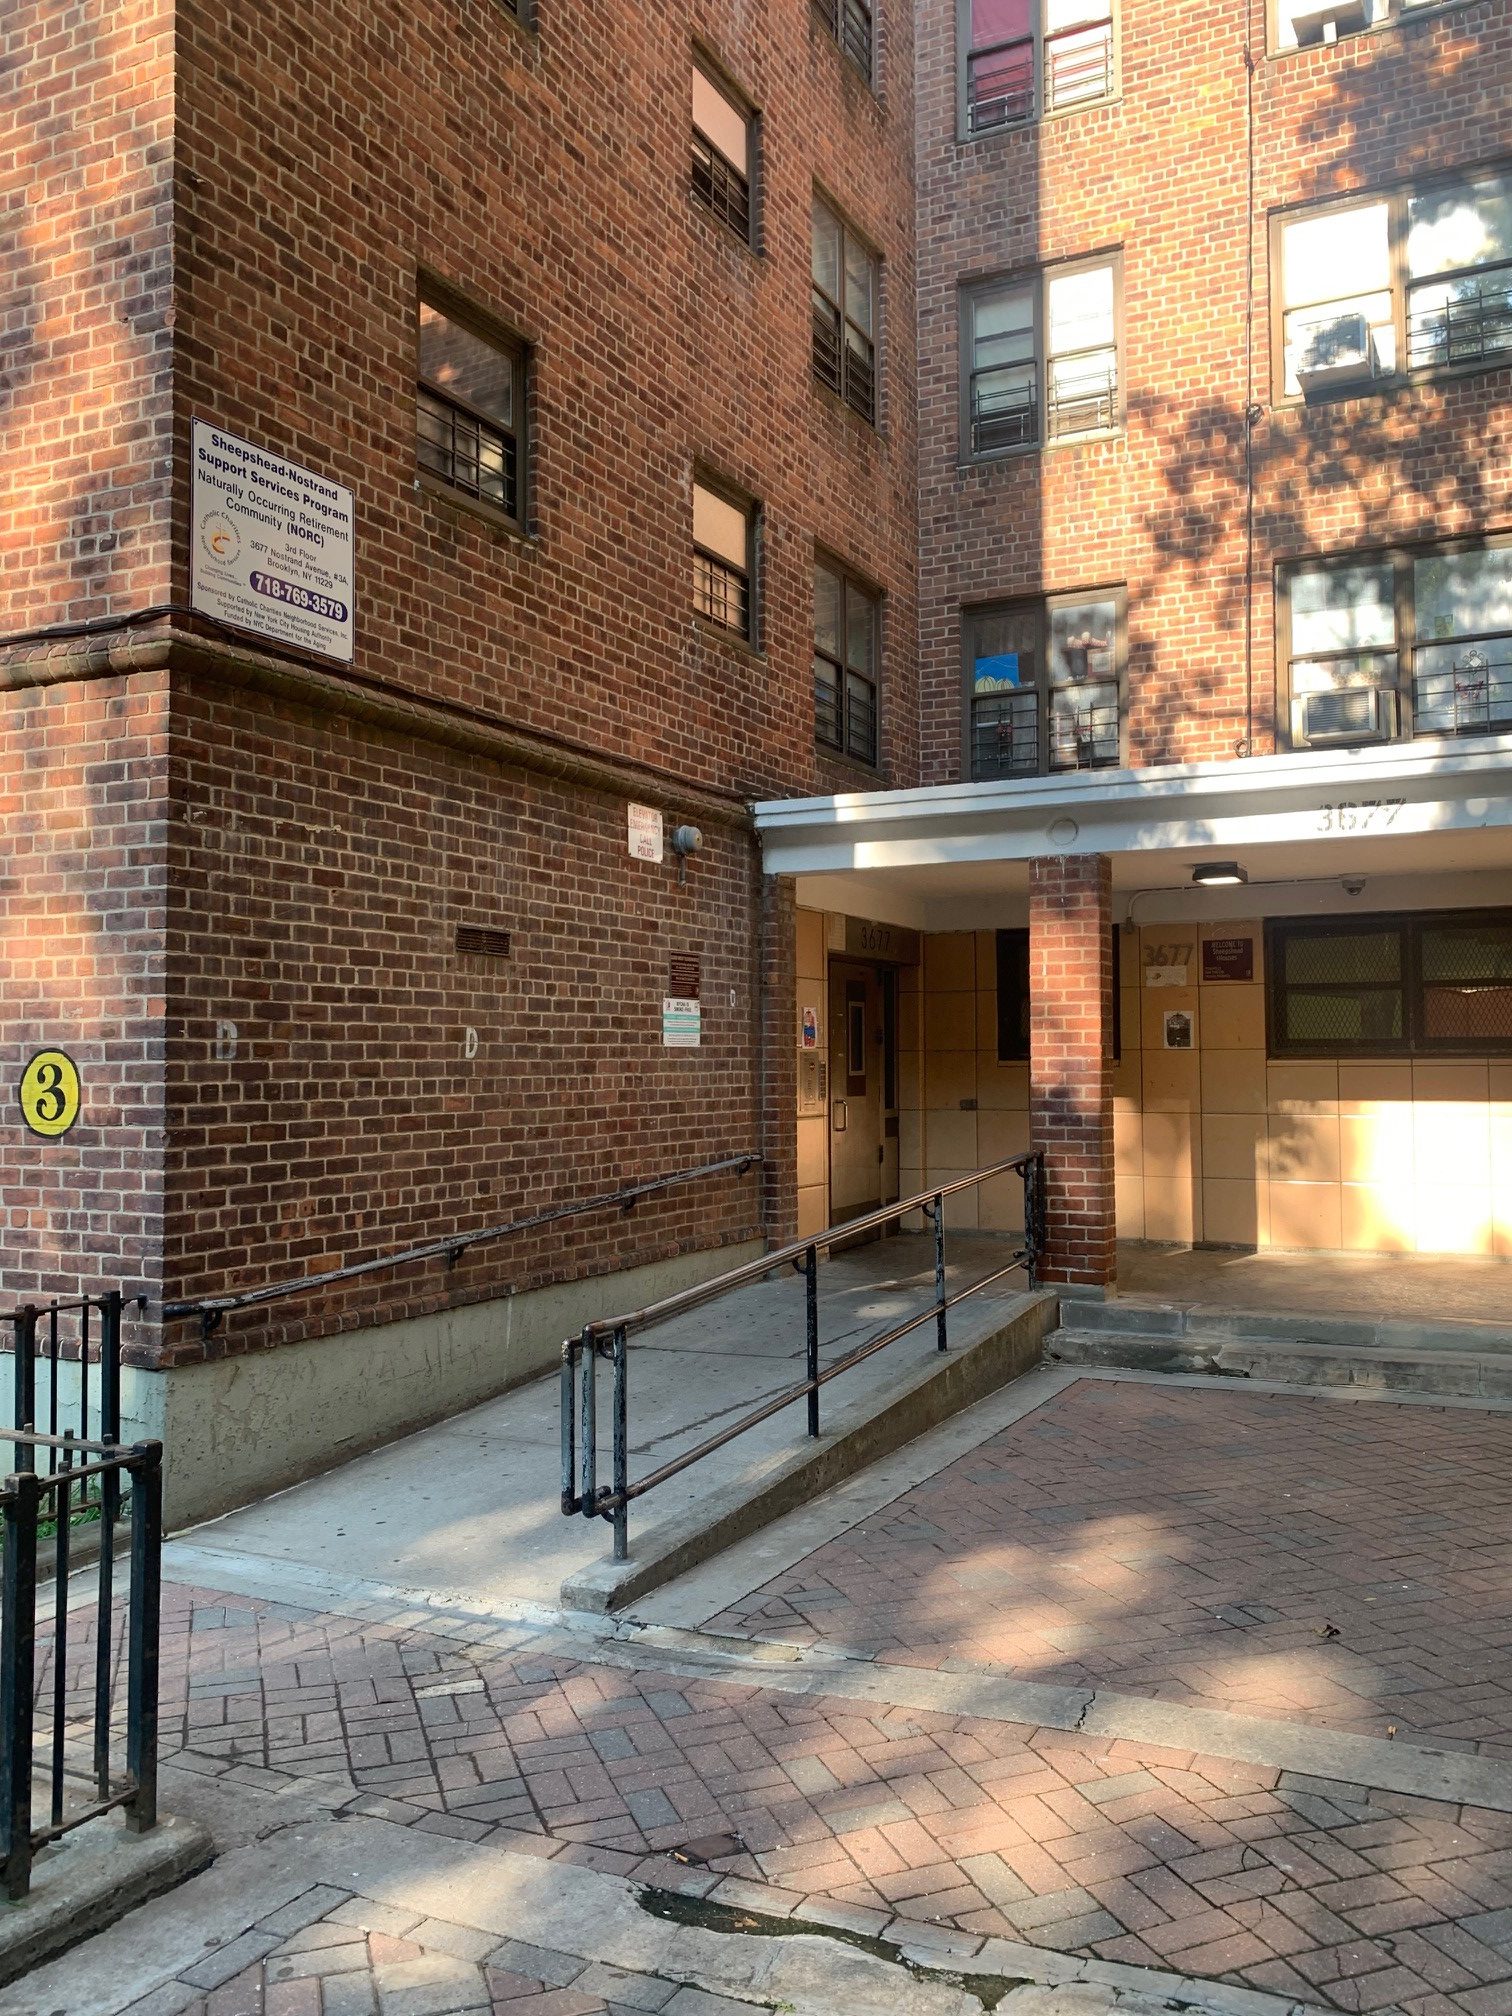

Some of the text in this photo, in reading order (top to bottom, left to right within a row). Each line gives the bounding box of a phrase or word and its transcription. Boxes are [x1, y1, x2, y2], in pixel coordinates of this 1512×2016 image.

[211, 433, 338, 501] Sheepshead-Nostrand
[198, 447, 349, 523] Support Services Program
[198, 468, 349, 542] Naturally Occurring Retirement
[226, 496, 325, 549] Community (NORC)
[249, 540, 269, 554] 3677
[270, 548, 303, 568] Nostrand
[284, 543, 317, 562] 3rd Floor
[196, 581, 227, 598] Sponsored
[228, 592, 235, 602] by
[255, 572, 343, 620] 718-769-3579
[302, 570, 313, 582] NY
[314, 576, 334, 590] 11229
[245, 608, 253, 618] by
[245, 616, 252, 626] by
[1317, 798, 1407, 832] 3677
[861, 926, 891, 950] 3677
[1143, 943, 1195, 967] 3677
[216, 1020, 238, 1060] D
[465, 1025, 479, 1059] D
[36, 1063, 66, 1122] 3
